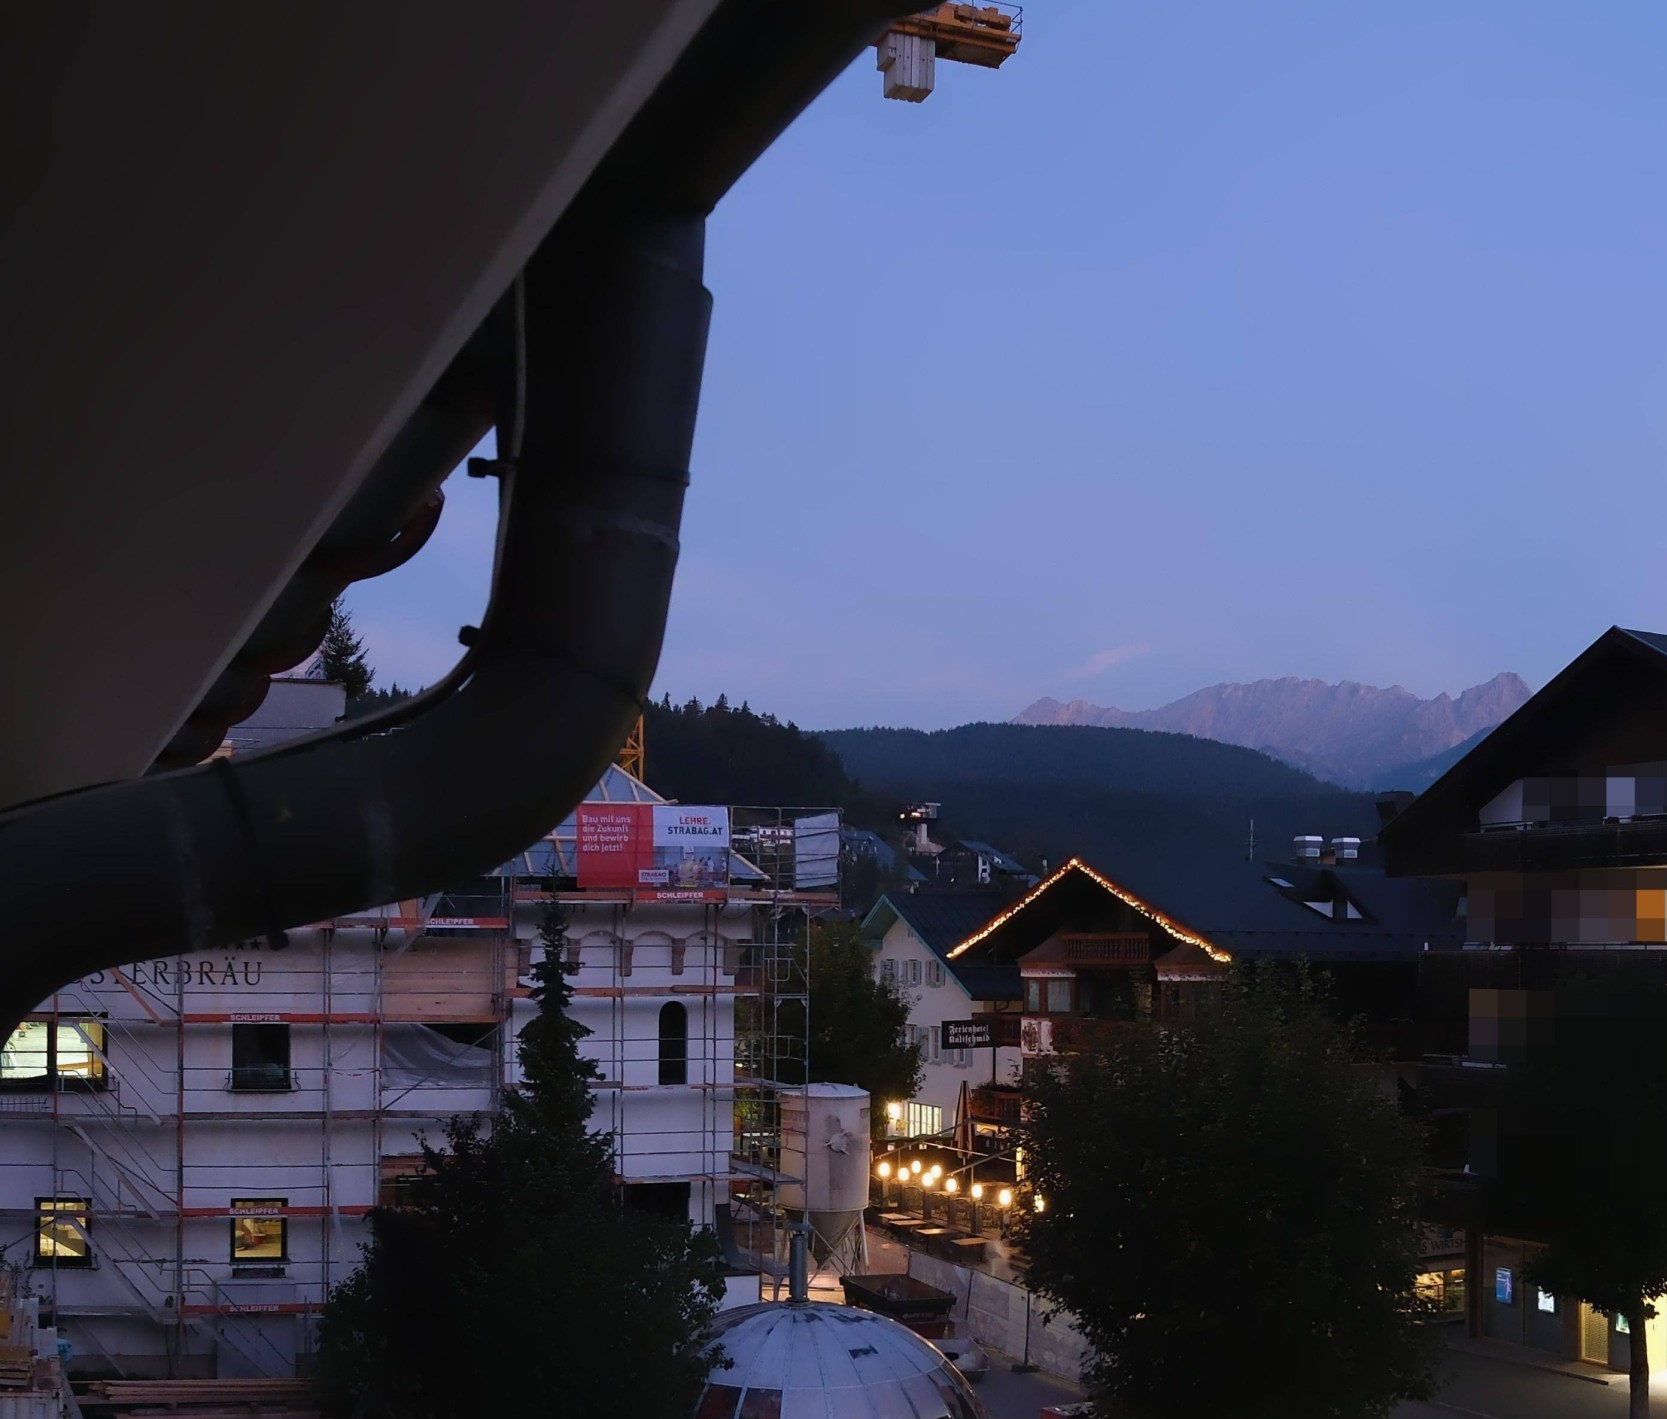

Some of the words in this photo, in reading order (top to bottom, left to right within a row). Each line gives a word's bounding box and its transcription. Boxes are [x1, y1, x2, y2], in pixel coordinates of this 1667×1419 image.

[582, 815, 598, 824] Bau
[600, 815, 614, 824] mit
[615, 816, 631, 824] uns
[679, 816, 711, 826] LEHRE.
[582, 825, 596, 833] die
[597, 825, 629, 833] Zukunft
[667, 826, 723, 836] STRABAG.AT
[582, 834, 598, 842] und
[600, 834, 629, 843] bewirb
[582, 843, 599, 852] dich
[601, 843, 623, 853] jetzt!
[656, 891, 704, 899] SCHLEIPFER
[229, 1013, 281, 1022] SCHLEIPFER
[948, 1024, 990, 1034] Ferienhotel
